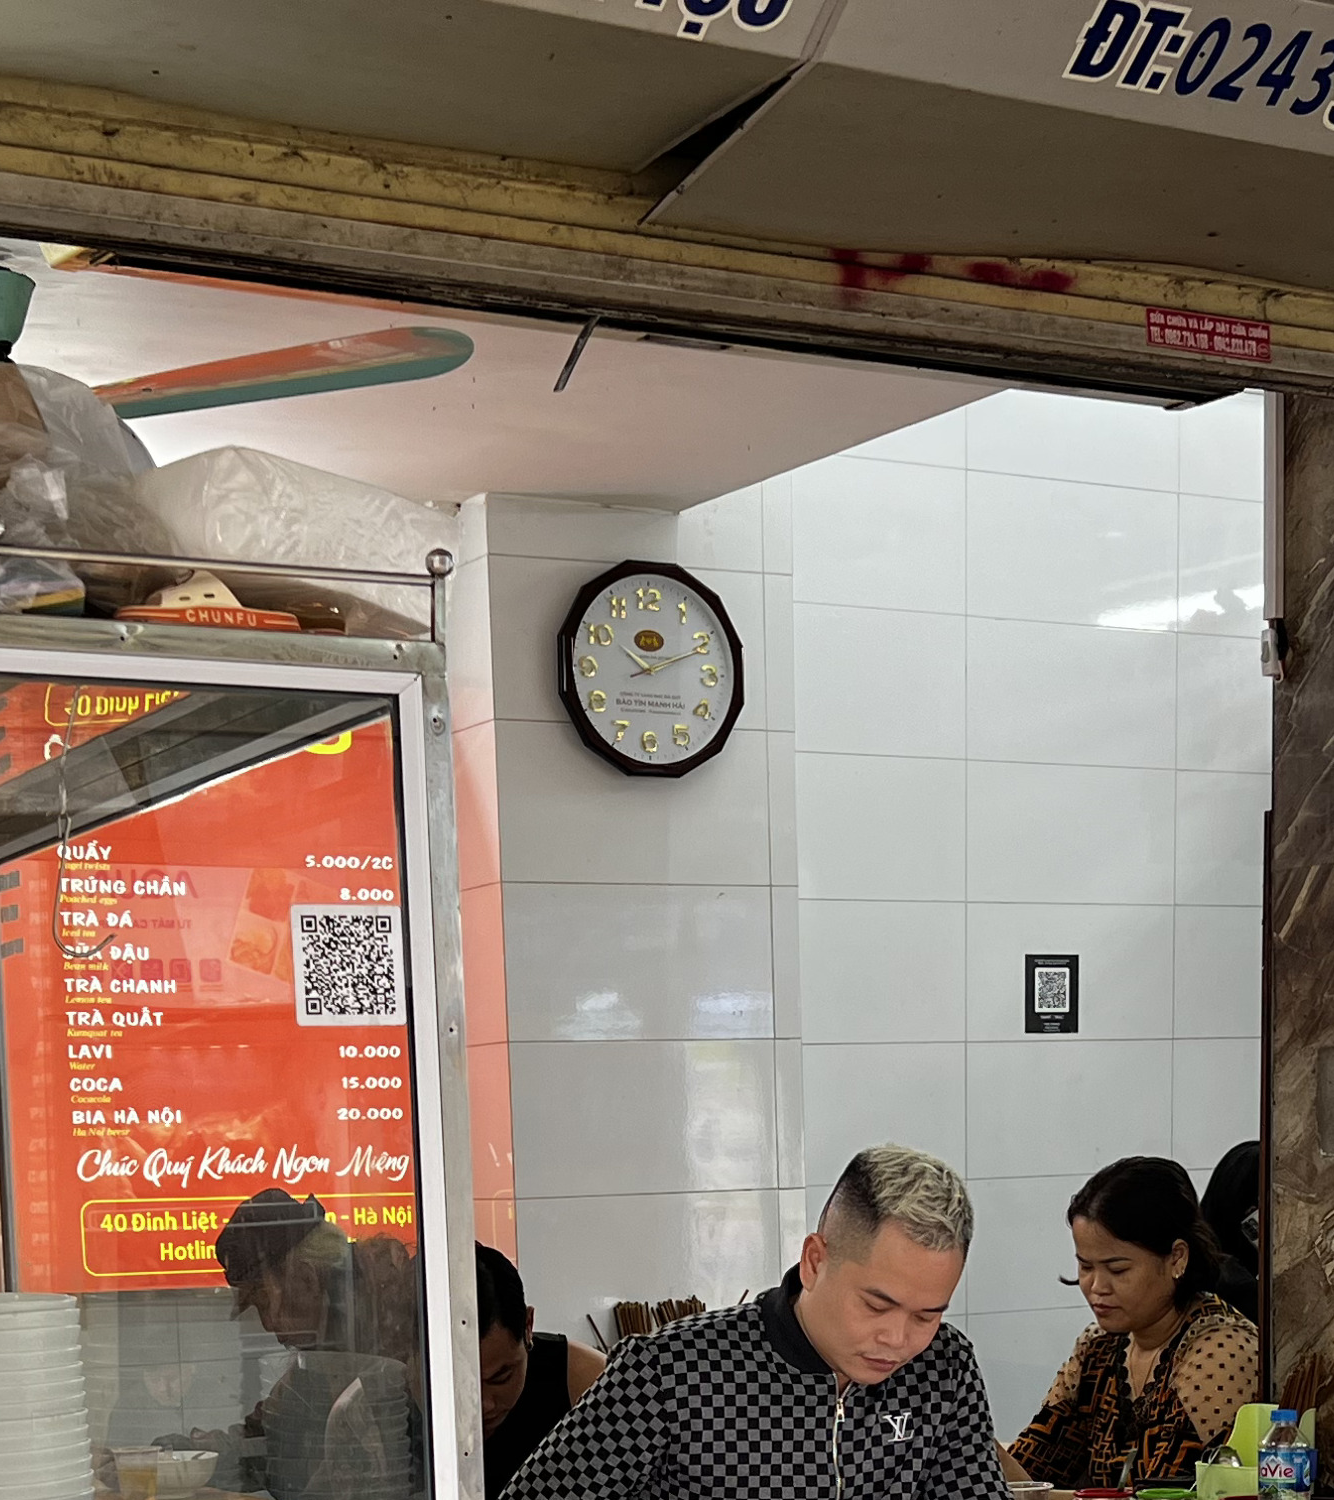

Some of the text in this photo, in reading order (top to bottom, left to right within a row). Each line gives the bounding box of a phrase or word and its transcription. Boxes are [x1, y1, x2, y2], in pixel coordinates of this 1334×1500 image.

[609, 596, 627, 619] 11
[636, 588, 662, 612] 12
[185, 609, 257, 626] CHUNFU
[677, 601, 687, 624] 1
[587, 623, 614, 646] 10
[692, 631, 711, 655] 2
[578, 655, 599, 678] 9
[701, 664, 718, 688] 3
[693, 698, 711, 720] 4
[612, 719, 630, 742] 7
[641, 731, 659, 752] 6
[673, 724, 690, 746] 5
[339, 887, 395, 902] 8.000
[59, 909, 100, 928] TRÀ
[105, 909, 134, 929] ĐÁ
[108, 942, 150, 965] ĐẬU
[63, 975, 178, 995] TRÀ CHANH
[65, 1008, 105, 1027] TRÀ
[68, 1043, 401, 1060] LAVI 10.000
[69, 1076, 402, 1093] COCA 15.000
[72, 1106, 404, 1127] BIA HÀ NỘI 20.000
[77, 1148, 139, 1183] Chúc
[142, 1147, 195, 1188] Quý
[197, 1146, 268, 1181] Khách
[272, 1144, 330, 1185] Ngon
[100, 1205, 412, 1233] 40 Đinh Liệt Hà Nội
[1259, 1463, 1294, 1478] aVie
